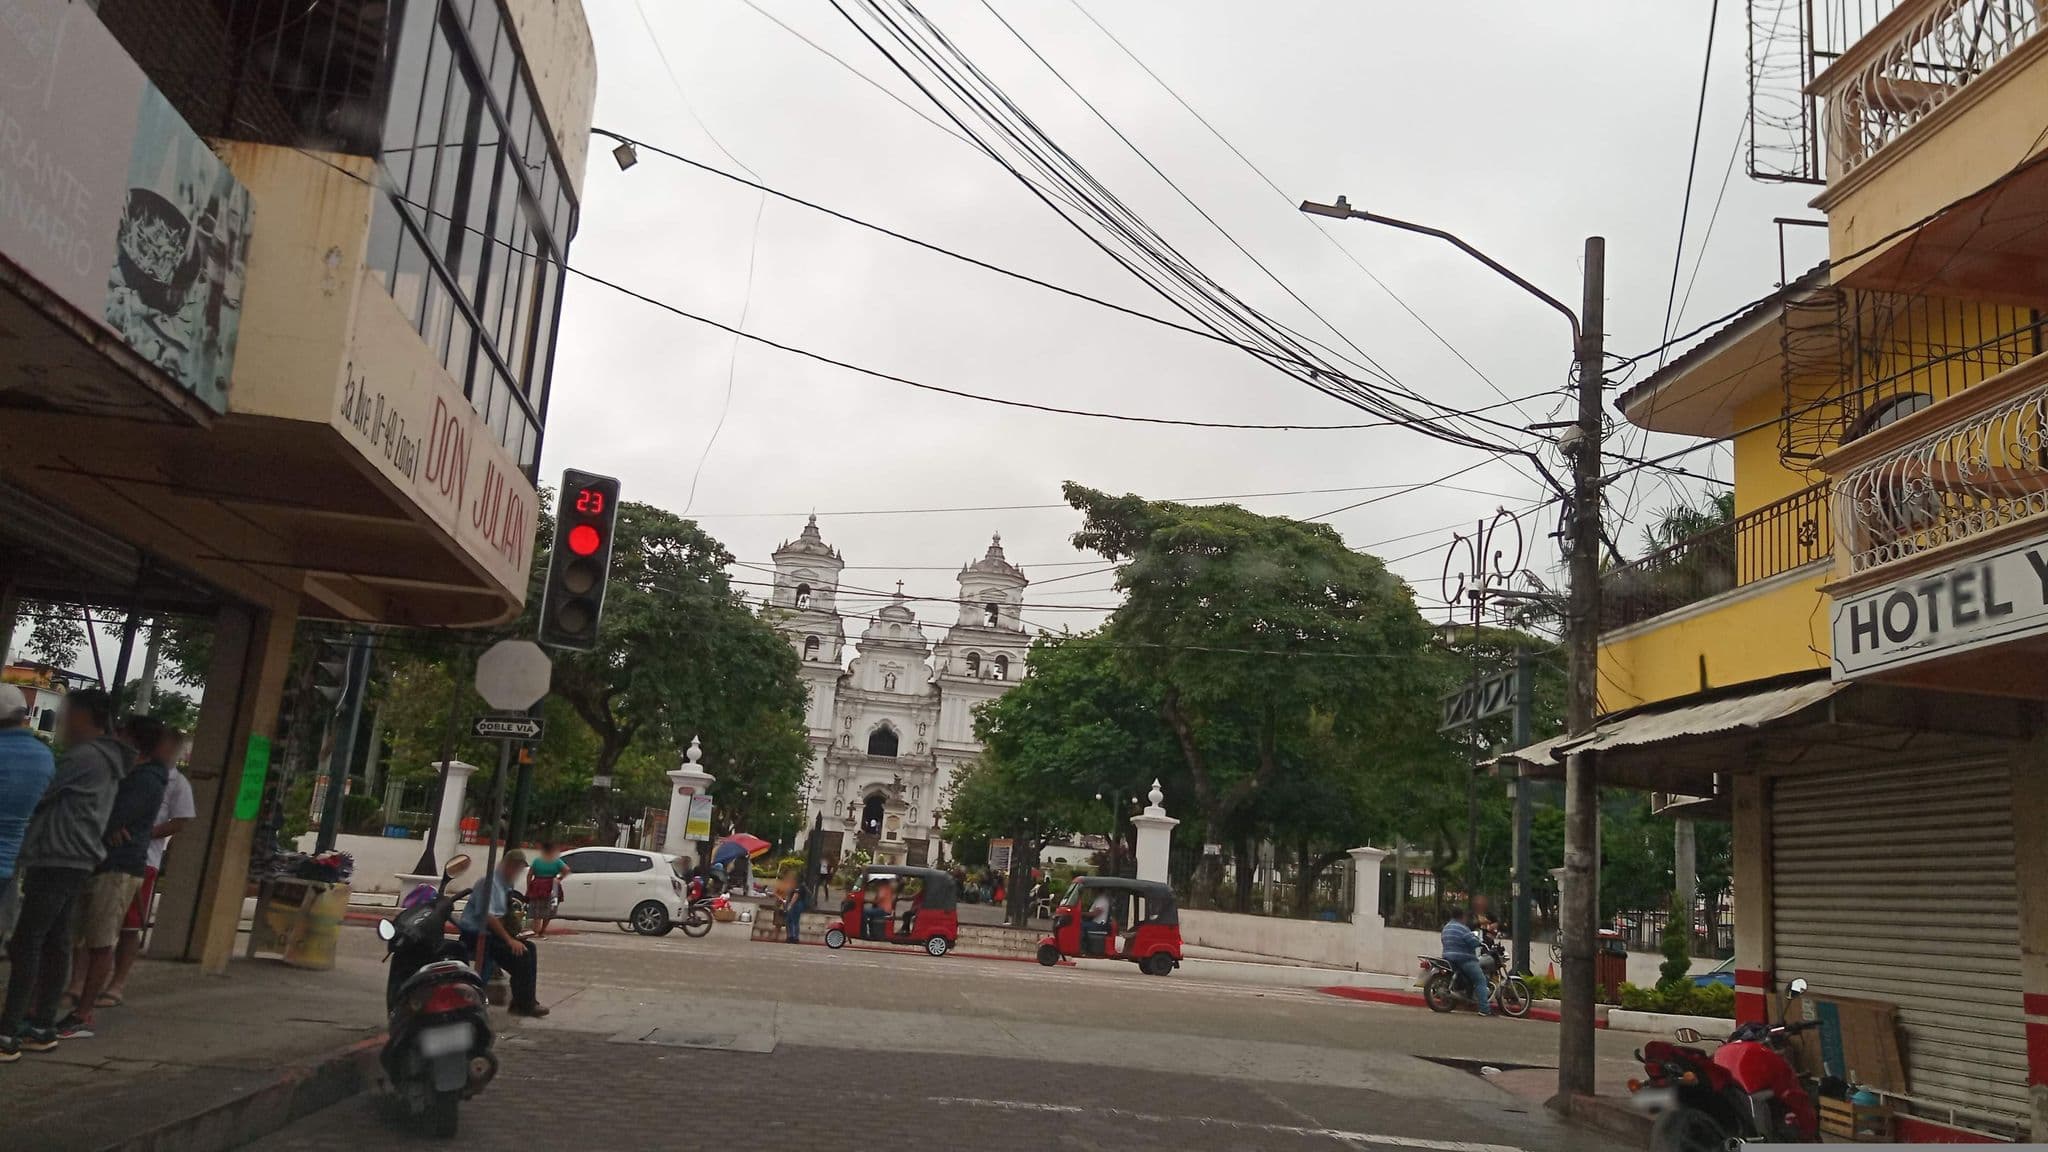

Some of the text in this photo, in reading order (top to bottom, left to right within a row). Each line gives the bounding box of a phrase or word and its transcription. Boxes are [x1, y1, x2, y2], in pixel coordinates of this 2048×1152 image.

[0, 109, 93, 227] RANTE
[426, 396, 530, 573] DON JULIAN
[576, 489, 603, 513] 23
[1850, 561, 2014, 655] HOTEL
[479, 722, 534, 733] DOBLE VIA
